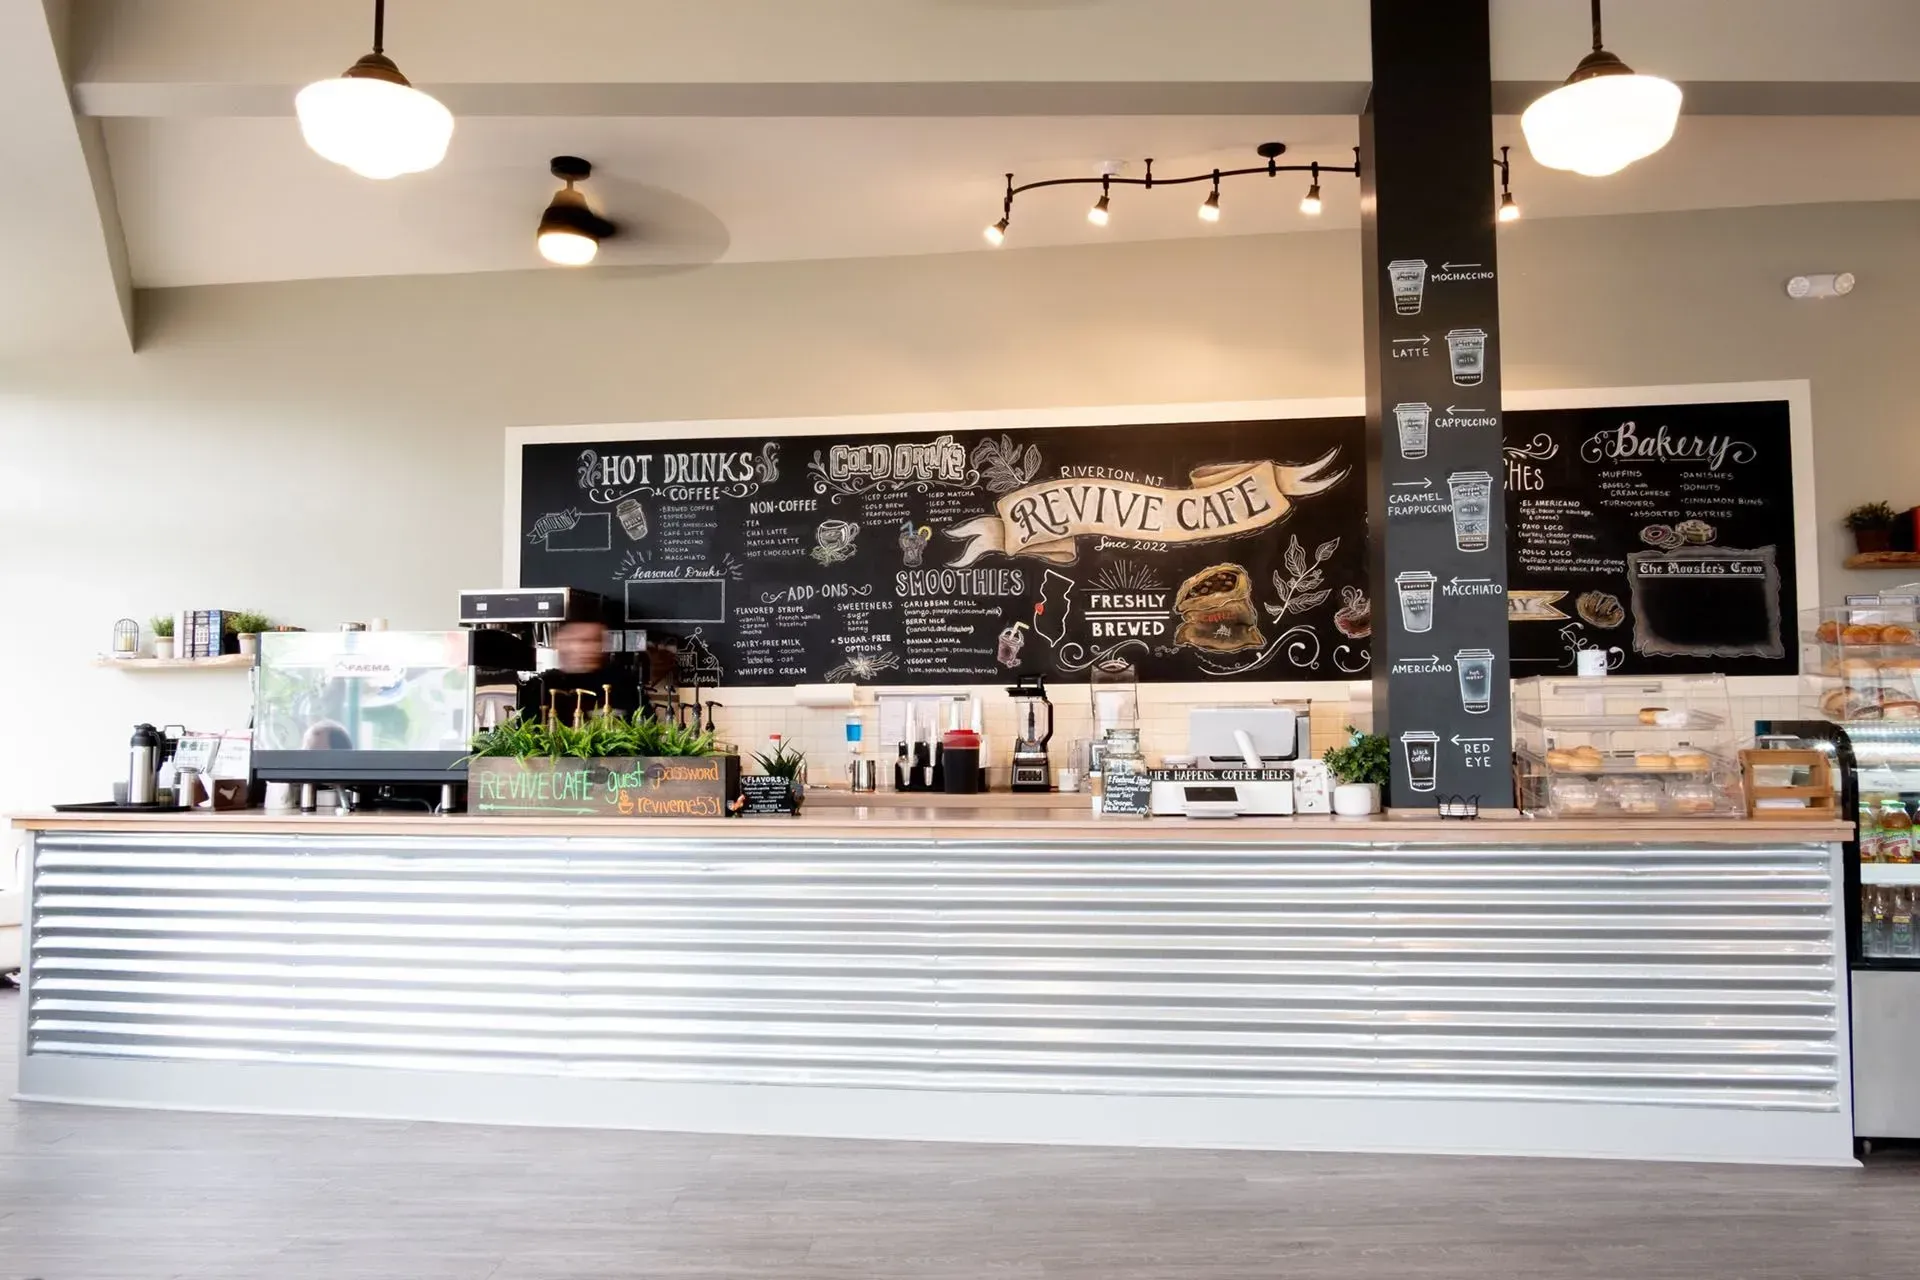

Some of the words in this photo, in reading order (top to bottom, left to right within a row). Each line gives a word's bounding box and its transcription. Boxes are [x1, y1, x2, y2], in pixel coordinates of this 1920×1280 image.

[1431, 272, 1494, 282] MOCHACCINO
[1392, 347, 1429, 358] LATTE
[1434, 417, 1497, 428] CAPPUCCINO
[1600, 421, 1732, 471] Bakery
[830, 444, 892, 481] COLD
[893, 435, 966, 481] DRINKS
[601, 454, 653, 486] HOT
[663, 452, 754, 484] DRINKS
[1602, 470, 1643, 478] MUFFINS
[1145, 474, 1163, 487] NJ
[1683, 471, 1735, 480] DANISHES
[1683, 483, 1721, 491] DONUTS
[670, 486, 720, 501] COFFEE
[883, 491, 908, 500] COFFEE
[928, 491, 945, 499] ICED
[947, 490, 975, 498] MATCHA
[1610, 489, 1639, 497] CREAM
[1389, 493, 1444, 504] CARAMEL
[1684, 497, 1735, 505] CINNAMON
[1738, 498, 1764, 506] BUNS
[690, 504, 714, 512] COFFEE
[865, 503, 882, 511] COLD
[1461, 505, 1479, 513] milk
[1603, 500, 1656, 508] TURNOVERS
[865, 510, 911, 518] FRAPPUCCINO
[930, 507, 961, 515] ASSORTED
[1010, 484, 1163, 545] REVIVE
[1175, 475, 1271, 533] CAFE
[1388, 504, 1453, 516] FRAPPUCCINO
[1634, 510, 1680, 518] ASSORTED
[1685, 510, 1733, 518] PASTRIES
[930, 515, 953, 523] WATER
[746, 529, 765, 537] CHAI
[766, 528, 788, 536] LATTE
[746, 539, 775, 547] MATCHA
[777, 537, 800, 545] LATTE
[1094, 535, 1130, 551] Since
[1132, 540, 1169, 552] 2022
[763, 548, 807, 557] CHOCOLATE
[1522, 548, 1546, 556] POLLO
[630, 565, 680, 580] Seasonal
[684, 565, 722, 579] Drinks
[1640, 562, 1662, 574] The
[1667, 561, 1725, 574] Rooster's
[1730, 561, 1763, 574] Crow
[895, 568, 1025, 597] SMOOTHIES
[787, 583, 849, 602] ADD-ONS
[1442, 584, 1503, 596] MACCHIATO
[904, 599, 950, 608] CARIBBEAN
[1091, 594, 1166, 608] FRESHLY
[736, 606, 774, 615] FLAVORED
[777, 606, 804, 614] SYRUPS
[837, 601, 893, 612] SWEETENERS
[847, 611, 869, 620] sugar
[929, 617, 945, 625] NICE
[1092, 621, 1166, 637] BREWED
[736, 639, 779, 648] DAIRY-FREE
[781, 639, 801, 647] MILK
[845, 644, 883, 653] OPTIONS
[737, 667, 774, 676] WHIPPED
[779, 667, 807, 675] CREAM
[1392, 664, 1453, 674] AMERICANO
[1464, 743, 1490, 754] RED
[1411, 755, 1432, 763] coffee
[1465, 756, 1491, 768] EYE
[1150, 770, 1170, 781] LIFE
[1221, 770, 1258, 781] COFFEE
[1261, 769, 1291, 780] HELPS
[479, 770, 550, 800] REVIVE
[552, 769, 595, 801] CAFE
[605, 761, 644, 804] guest
[652, 759, 720, 790] password
[637, 796, 722, 816] reviveme531
